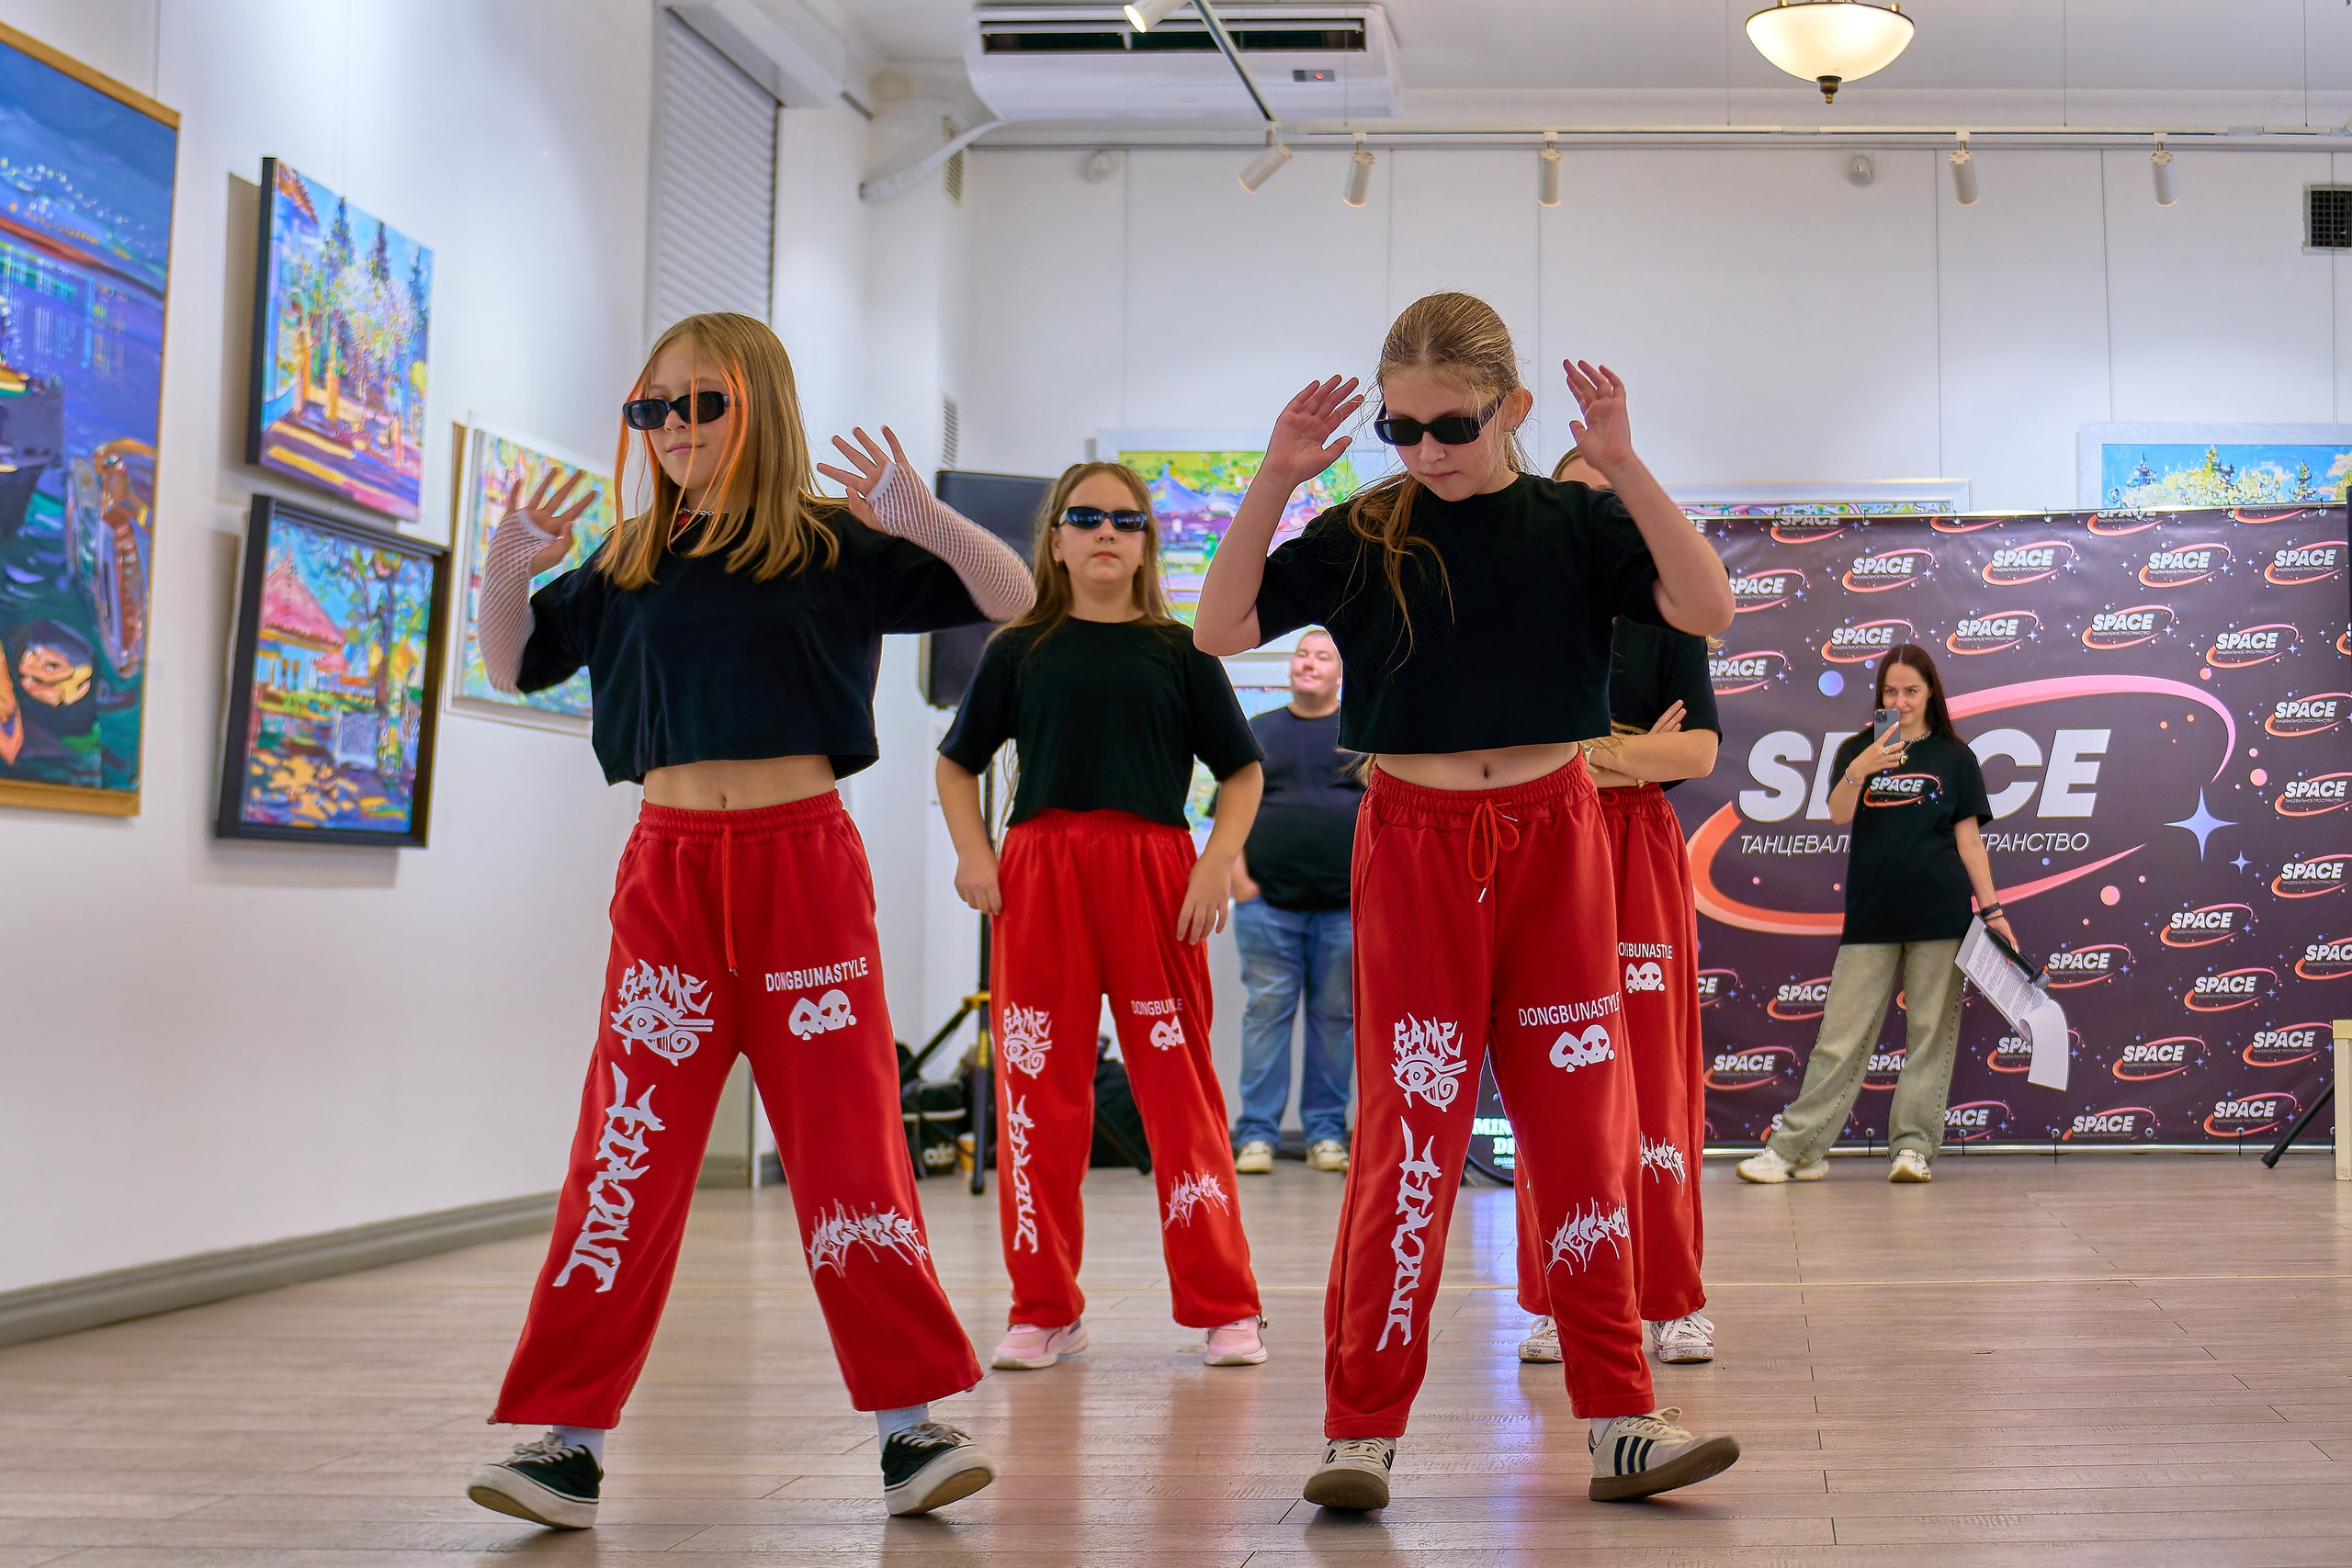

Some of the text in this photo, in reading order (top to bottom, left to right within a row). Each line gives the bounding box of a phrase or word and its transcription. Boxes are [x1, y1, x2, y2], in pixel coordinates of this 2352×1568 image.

[1851, 557, 1915, 574] SPACE
[1992, 549, 2054, 567] SPACE
[2148, 551, 2211, 569] SPACE
[2273, 549, 2336, 567] SPACE
[1956, 619, 2018, 637] SPACE
[2092, 614, 2154, 631] SPACE
[1830, 628, 1893, 645] SPACE
[2215, 632, 2278, 649] SPACE
[1709, 660, 1767, 677] SPACE
[2275, 701, 2337, 718] SPACE
[1738, 728, 2112, 823] SCE
[1870, 776, 1926, 794] SPACE
[2284, 781, 2347, 798] SPACE
[1741, 834, 1850, 857] ТАНЦЕВАЛ
[2281, 863, 2344, 880] SPACE
[2170, 912, 2233, 930] SPACE
[2048, 953, 2110, 970] SPACE
[2304, 944, 2352, 962] SPAC
[765, 956, 869, 992] DONGBUNASTYLE
[1777, 985, 1831, 1001] SPAC
[2194, 976, 2256, 994] SPACE
[1996, 1037, 2031, 1054] SPA
[2253, 1031, 2315, 1048] SPACE
[2122, 1045, 2185, 1062] SPACE
[1713, 1055, 1775, 1072] SPACE
[1867, 1055, 1905, 1071] SPA
[2214, 1101, 2277, 1119] SPACE
[2072, 1115, 2134, 1133] SPACE
